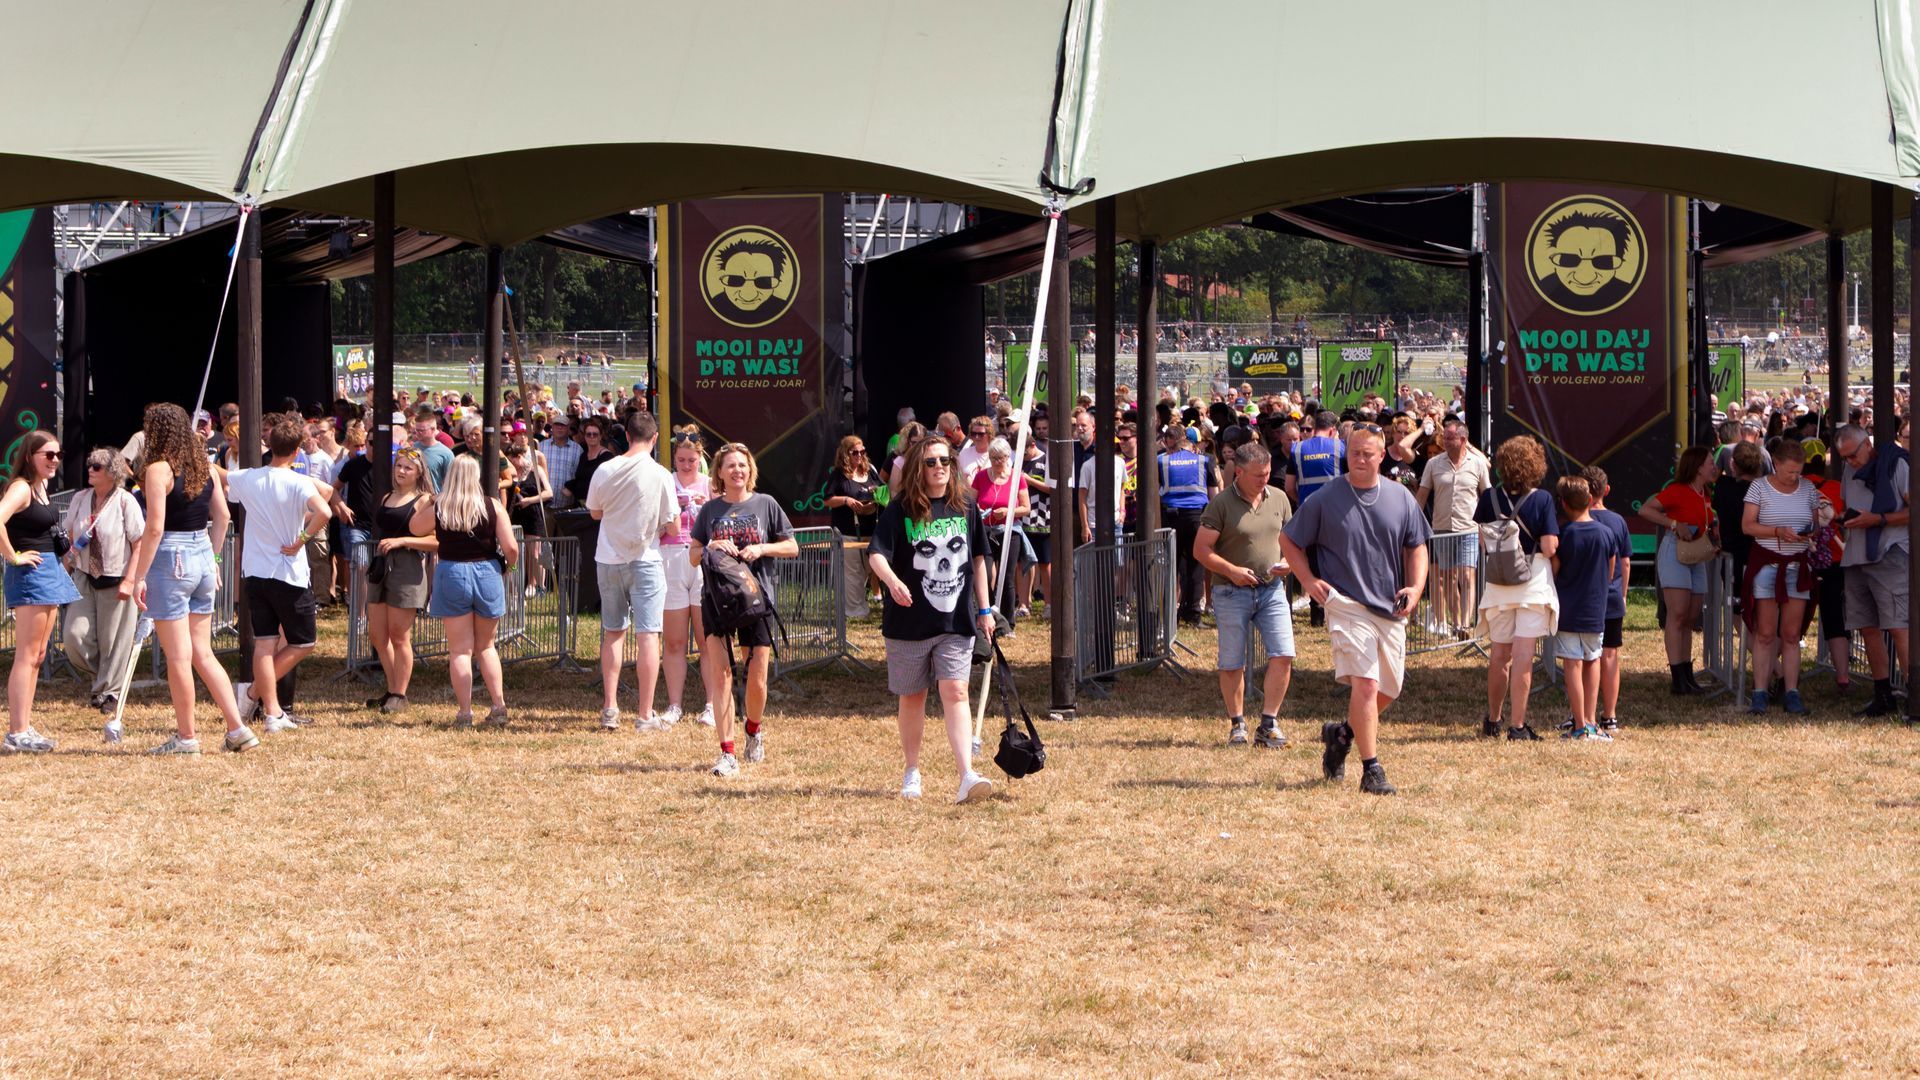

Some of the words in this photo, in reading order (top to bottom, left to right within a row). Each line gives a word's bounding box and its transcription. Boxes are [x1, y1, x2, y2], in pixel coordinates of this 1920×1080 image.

[1520, 329, 1588, 349] MOOI
[1596, 328, 1650, 349] DA'J
[696, 339, 752, 356] MOOI
[758, 338, 803, 356] DA'J
[1249, 351, 1279, 365] AFVAL
[1525, 352, 1569, 372] D'R
[1576, 352, 1645, 372] WAS!
[700, 359, 736, 376] D'R
[742, 358, 799, 375] WAS!
[720, 379, 770, 388] VOLGEND
[773, 379, 806, 388] JOAR!
[1332, 361, 1385, 398] AJOW!
[1552, 375, 1607, 385] VOLGEND
[1609, 375, 1645, 384] JOAR!
[1169, 459, 1198, 467] SECURITY
[1303, 453, 1331, 461] SECURITY
